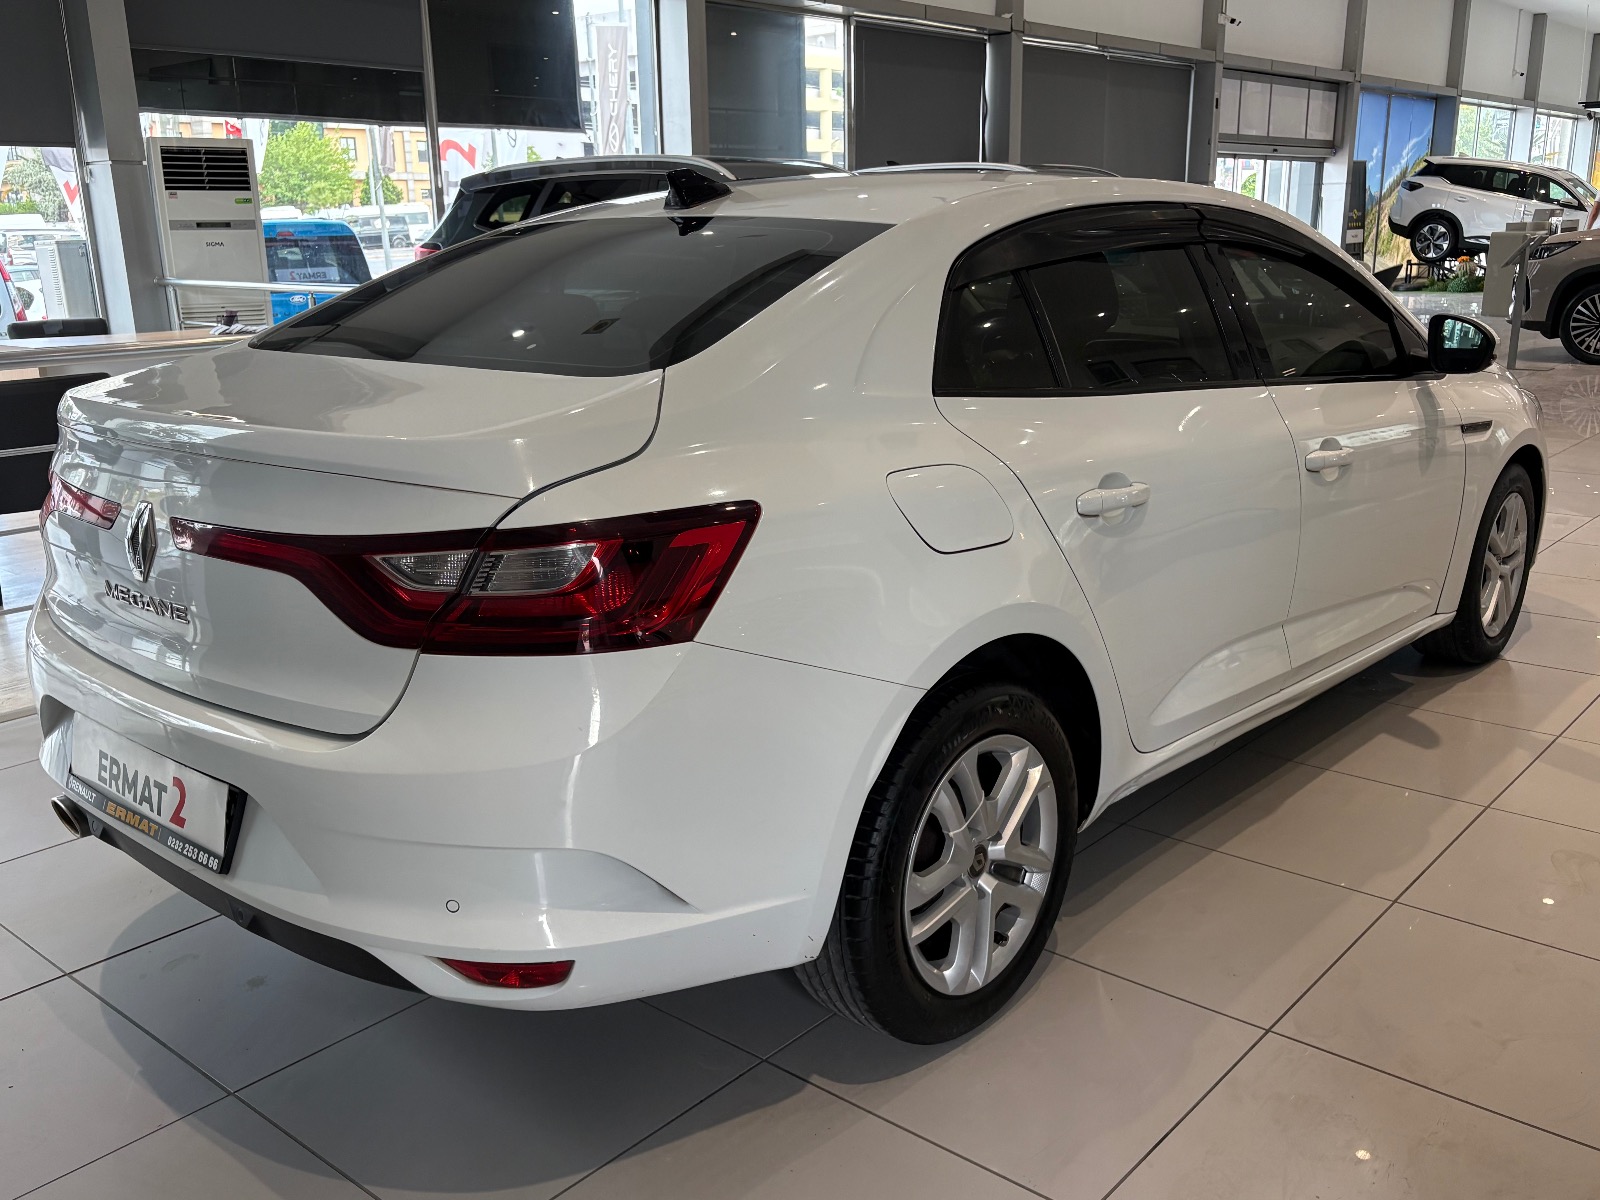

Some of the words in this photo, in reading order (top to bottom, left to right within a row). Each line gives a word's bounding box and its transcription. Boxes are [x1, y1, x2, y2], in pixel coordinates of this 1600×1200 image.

[607, 43, 619, 116] CHERY
[104, 579, 190, 625] MEGANE
[71, 779, 97, 803] RENAULT
[106, 801, 159, 838] ERMAT
[167, 835, 184, 852] 0232
[183, 843, 199, 860] 253
[198, 851, 209, 865] 66
[208, 856, 219, 871] 66
[97, 749, 168, 817] ERMAT
[169, 776, 187, 829] 2
